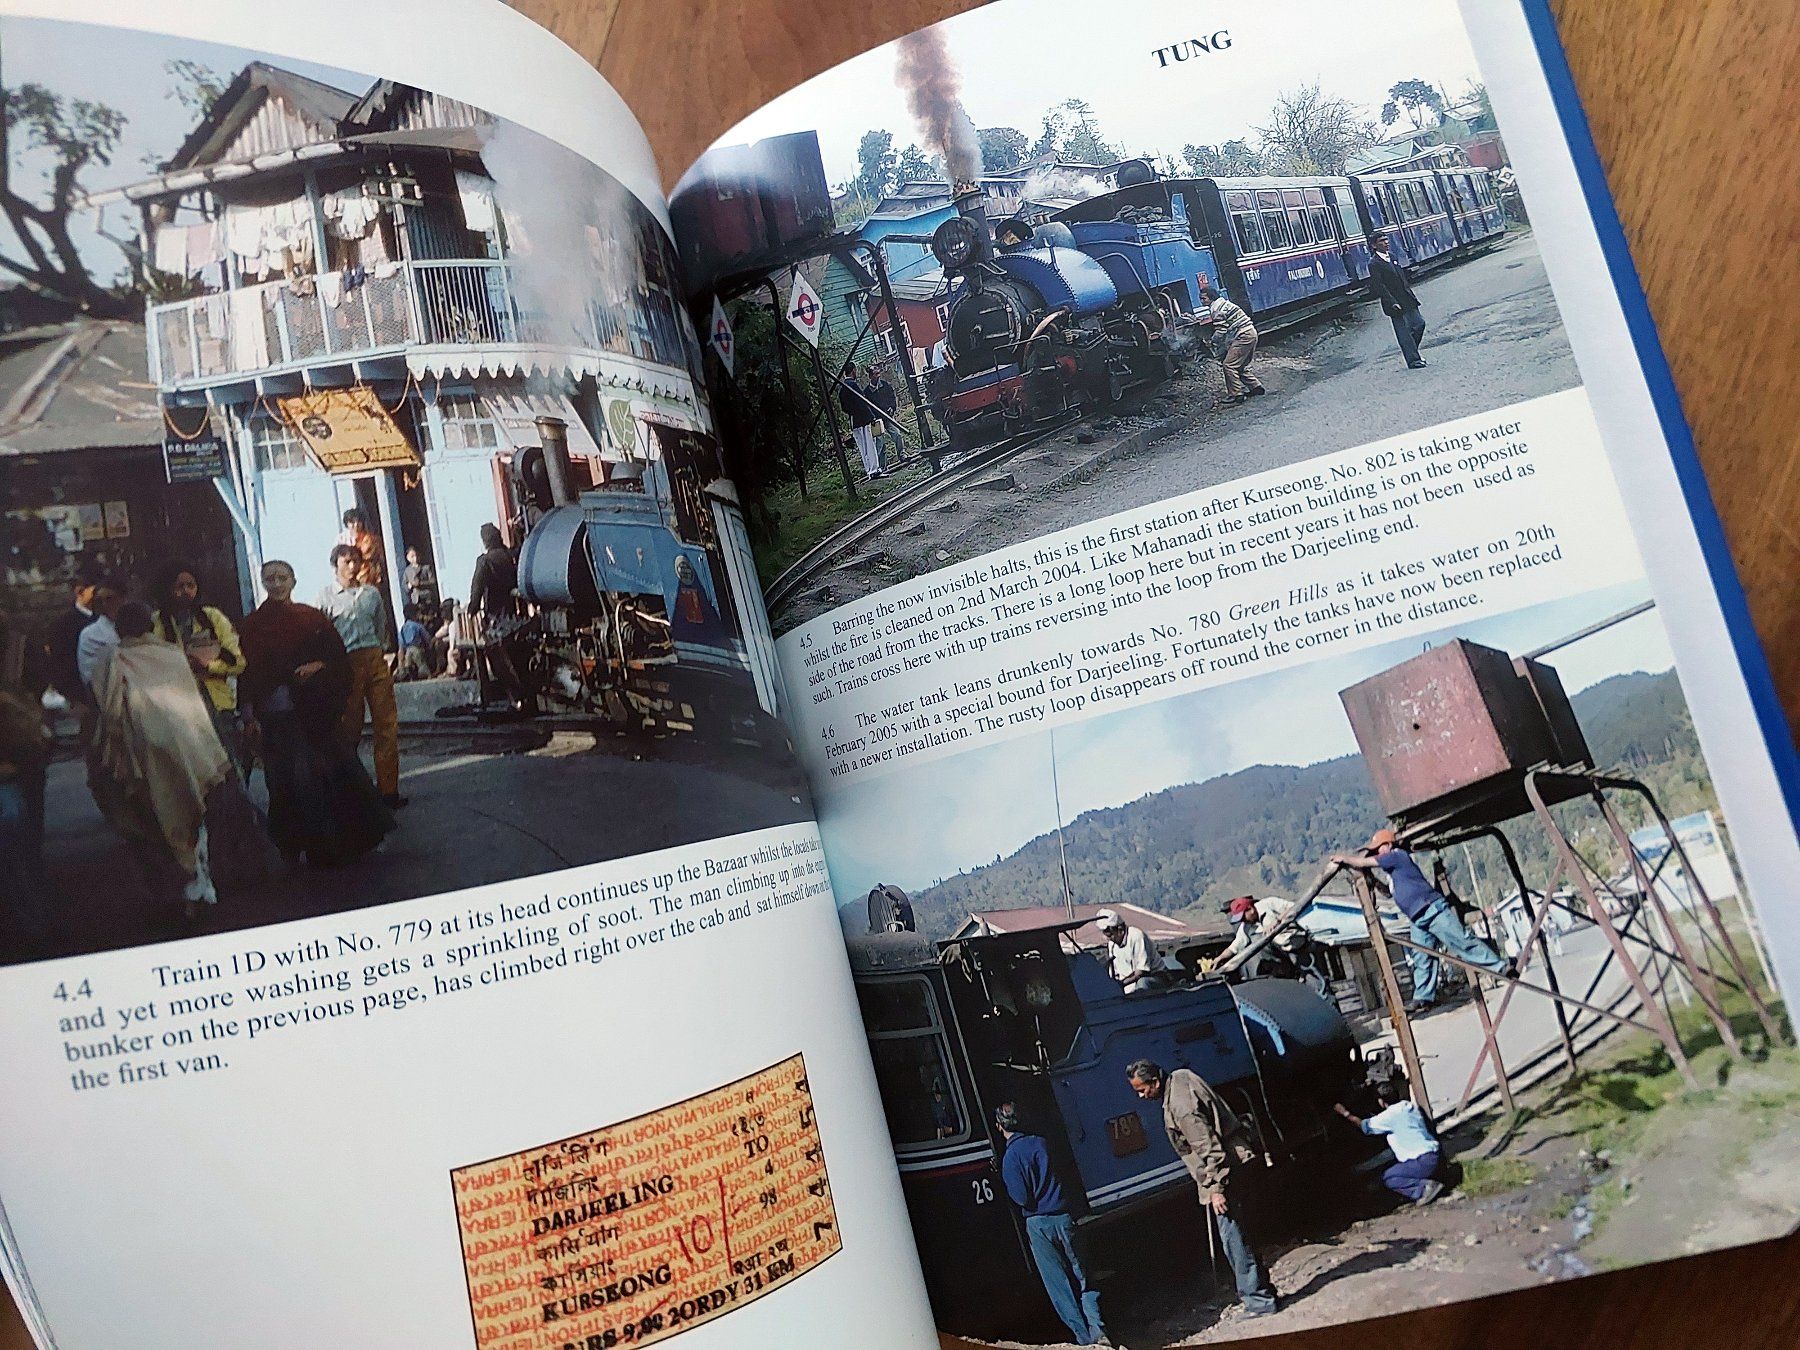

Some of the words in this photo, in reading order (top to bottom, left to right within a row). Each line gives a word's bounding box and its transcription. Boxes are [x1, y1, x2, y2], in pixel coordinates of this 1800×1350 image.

[1151, 30, 1232, 68] TUNG
[799, 632, 812, 649] 4.5
[831, 611, 874, 635] Barring
[896, 591, 924, 610] now
[927, 569, 988, 599] invisible
[989, 558, 1031, 579] halts,
[1033, 546, 1061, 565] this
[1108, 523, 1141, 543] first
[1144, 509, 1198, 533] station
[1201, 497, 1238, 517] after
[1241, 475, 1327, 505] Kurseong.
[1328, 464, 1361, 481] No.
[1364, 451, 1397, 472] 802
[1418, 435, 1472, 457] taking
[1473, 421, 1520, 442] water
[803, 646, 830, 668] whilst
[848, 633, 868, 649] fire
[884, 606, 934, 635] cleaned
[957, 589, 986, 611] 2nd
[987, 574, 1038, 601] March
[1041, 560, 1085, 585] 2004.
[1089, 550, 1127, 570] Like
[1130, 522, 1212, 558] Mahanadi
[1247, 503, 1303, 526] station
[1305, 483, 1377, 510] building
[1457, 441, 1528, 471] opposite
[808, 668, 825, 687] side
[856, 644, 882, 667] road
[884, 637, 916, 656] from
[941, 614, 988, 636] tracks.
[990, 600, 1035, 621] There
[1068, 579, 1105, 598] long
[1107, 568, 1144, 587] loop
[1146, 557, 1184, 576] here
[1186, 547, 1215, 564] but
[1239, 526, 1291, 551] recent
[1294, 515, 1339, 540] years
[1358, 502, 1388, 519] has
[1392, 492, 1419, 510] not
[1422, 482, 1464, 501] been
[1473, 464, 1512, 488] used
[812, 687, 834, 704] such.
[834, 674, 868, 694] Trains
[870, 663, 901, 681] cross
[901, 653, 931, 671] here
[933, 639, 965, 660] with
[990, 622, 1031, 643] trains
[1035, 601, 1108, 630] reversing
[1110, 591, 1142, 608] into
[1174, 572, 1212, 590] loop
[1216, 560, 1257, 579] from
[1290, 528, 1380, 559] Darjeeling
[1383, 513, 1418, 535] end.
[821, 723, 838, 742] 4.6
[853, 711, 877, 728] The
[880, 700, 914, 719] water
[919, 686, 950, 707] tank
[953, 677, 991, 697] leans
[997, 652, 1073, 684] drunkenly
[1080, 631, 1145, 660] towards
[1149, 624, 1182, 641] No.
[1188, 610, 1220, 631] 780
[1228, 598, 1280, 620] Green
[1288, 582, 1328, 606] Hills
[1380, 561, 1424, 581] takes
[1430, 546, 1479, 567] water
[1515, 523, 1555, 546] 20th
[824, 736, 866, 759] February
[868, 722, 897, 744] 2005
[900, 713, 930, 733] with
[944, 693, 994, 723] special
[996, 679, 1045, 705] bound
[1048, 675, 1072, 691] for
[1075, 652, 1167, 683] Darjeeling.
[1171, 622, 1267, 658] Fortunately
[1304, 602, 1350, 623] tanks
[1353, 591, 1395, 611] have
[1400, 580, 1435, 599] now
[1440, 569, 1483, 588] been
[1488, 543, 1561, 576] replaced
[829, 759, 850, 777] with
[857, 748, 892, 768] newer
[894, 727, 972, 757] installation.
[974, 715, 1004, 733] The
[1007, 704, 1045, 724] rusty
[1049, 695, 1085, 713] loop
[1090, 670, 1176, 702] disappears
[1180, 658, 1205, 678] off
[1209, 644, 1259, 671] round
[1295, 625, 1348, 649] corner
[1407, 593, 1483, 620] distance.
[53, 978, 92, 1002] 4.4
[151, 959, 220, 987] Train
[231, 950, 265, 974] 1D
[273, 939, 329, 966] with
[336, 933, 380, 955] No.
[388, 918, 432, 945] 779
[467, 909, 493, 929] its
[499, 893, 550, 922] head
[556, 878, 648, 910] continues
[677, 863, 700, 883] the
[703, 855, 747, 876] Bazaar
[749, 844, 780, 865] whilst
[780, 840, 792, 858] the
[59, 1006, 105, 1032] and
[117, 1001, 156, 1029] yet
[169, 992, 233, 1015] more
[245, 969, 351, 1002] washing
[362, 957, 410, 986] gets
[446, 925, 559, 967] sprinkling
[598, 905, 642, 929] soot.
[649, 894, 682, 915] The
[689, 887, 721, 906] man
[726, 871, 777, 897] climbing
[63, 1034, 153, 1061] bunker
[201, 1018, 238, 1040] the
[246, 999, 354, 1038] previous
[362, 986, 426, 1016] page,
[433, 974, 472, 995] has
[479, 946, 567, 984] climbed
[573, 936, 620, 964] right
[625, 927, 665, 949] over
[669, 918, 695, 937] the
[699, 907, 724, 929] cab
[728, 899, 752, 922] and
[756, 895, 773, 914] sat
[772, 883, 804, 910] himself
[71, 1068, 109, 1090] the
[118, 1060, 168, 1084] first
[176, 1054, 228, 1073] van.
[744, 1135, 768, 1158] TO
[531, 1174, 674, 1237] DARJEELING
[972, 1178, 993, 1204] 26
[542, 1264, 672, 1322] KURSEONG
